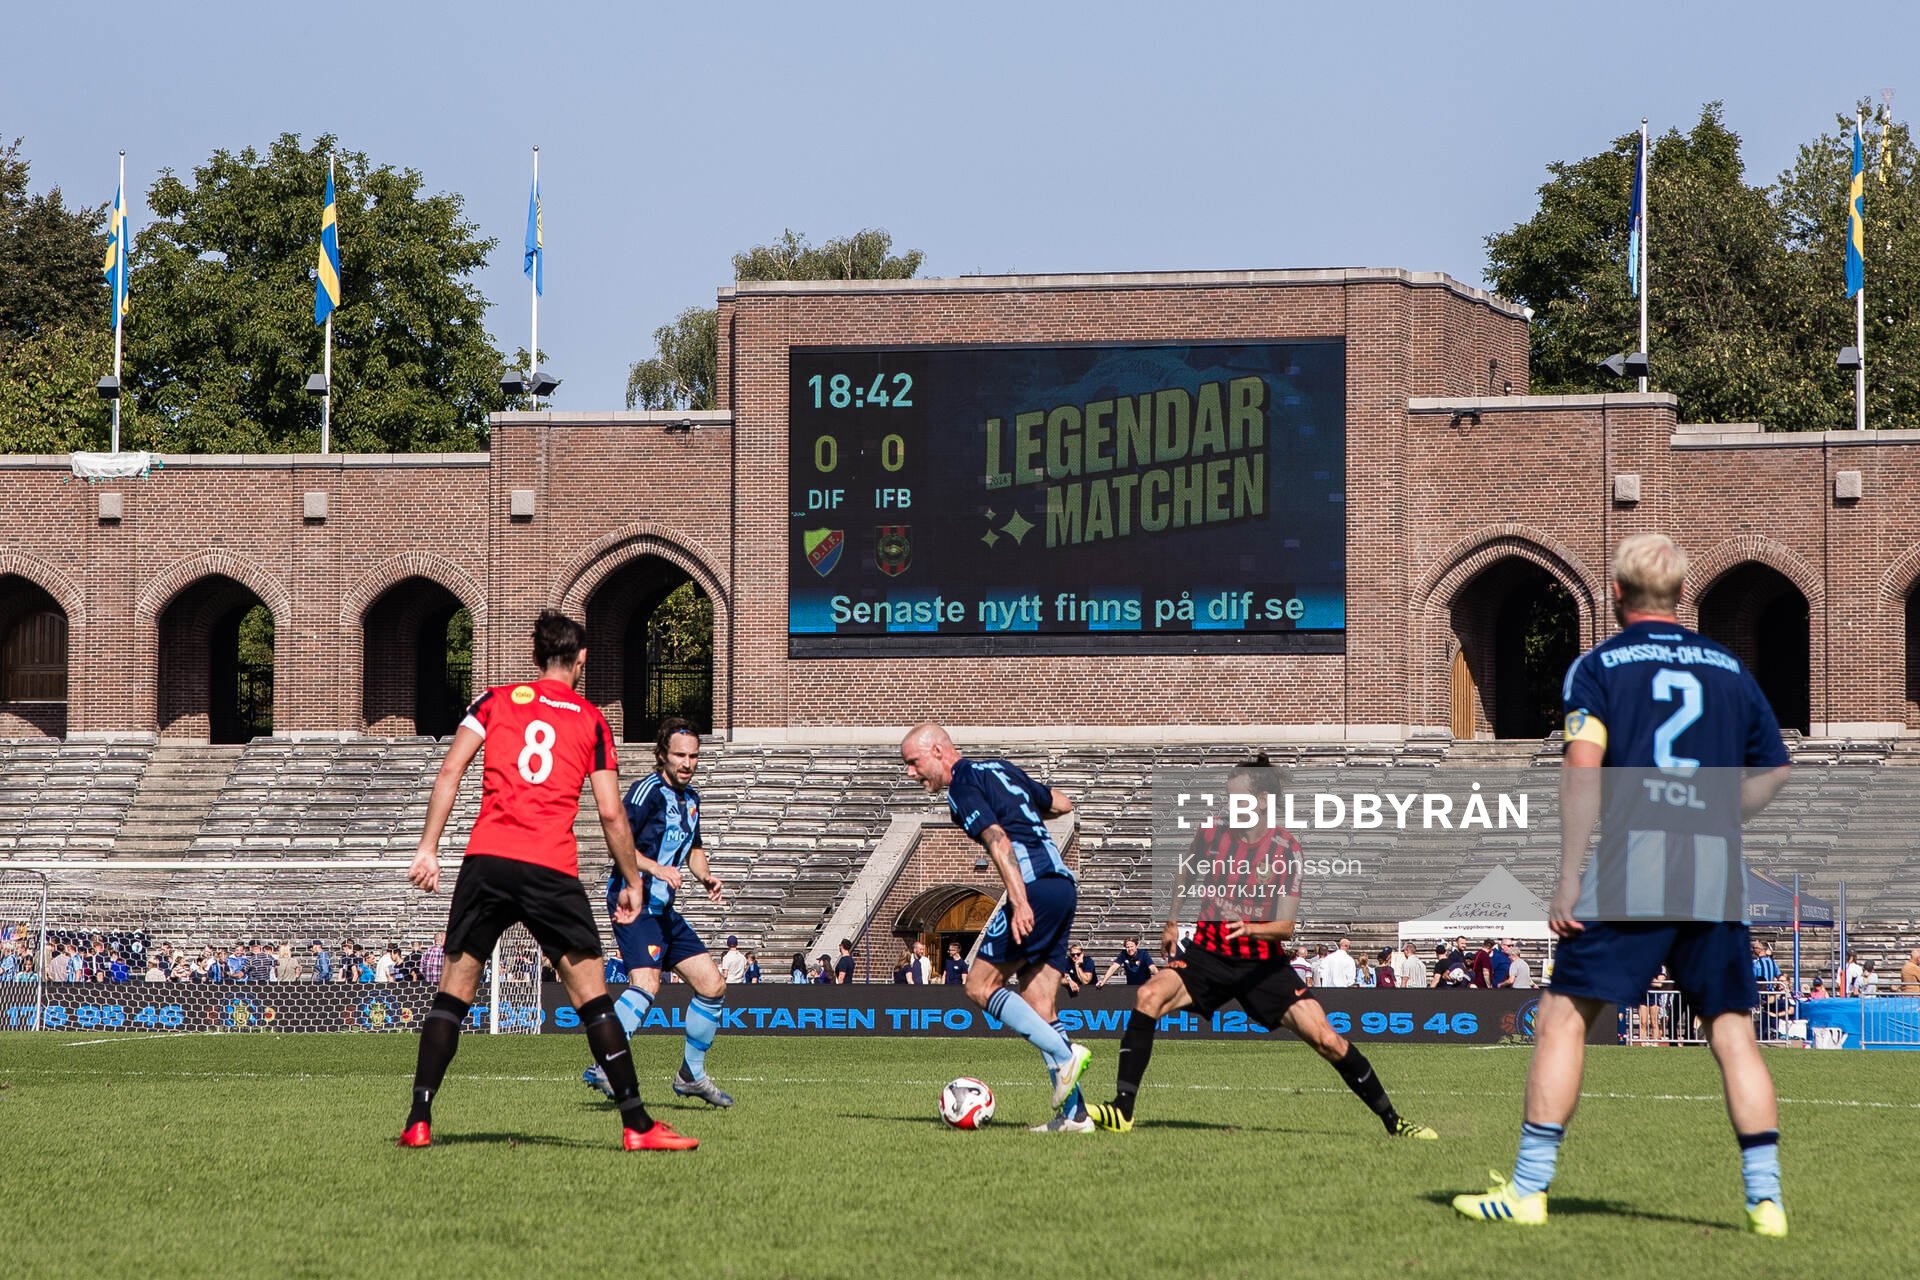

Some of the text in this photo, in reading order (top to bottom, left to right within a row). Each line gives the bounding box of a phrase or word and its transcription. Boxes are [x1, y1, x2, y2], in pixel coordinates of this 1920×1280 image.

[808, 372, 913, 409] 18:42
[985, 375, 1265, 490] LEGENDAR
[815, 434, 838, 473] 0
[882, 433, 905, 472] 0
[807, 489, 845, 509] DIF
[874, 488, 911, 508] IFB
[1046, 453, 1264, 549] MATCHEN
[830, 591, 1305, 629] Senaste nytt finns på dif.se
[1652, 668, 1704, 778] 2
[517, 719, 557, 785] 8
[1643, 777, 1706, 811] TCL
[554, 1006, 875, 1030] SALKTAREN
[884, 1008, 973, 1031] TIFO
[1056, 1009, 1198, 1032] SWIH:
[1360, 1012, 1415, 1035] 95
[1423, 1012, 1478, 1035] 46
